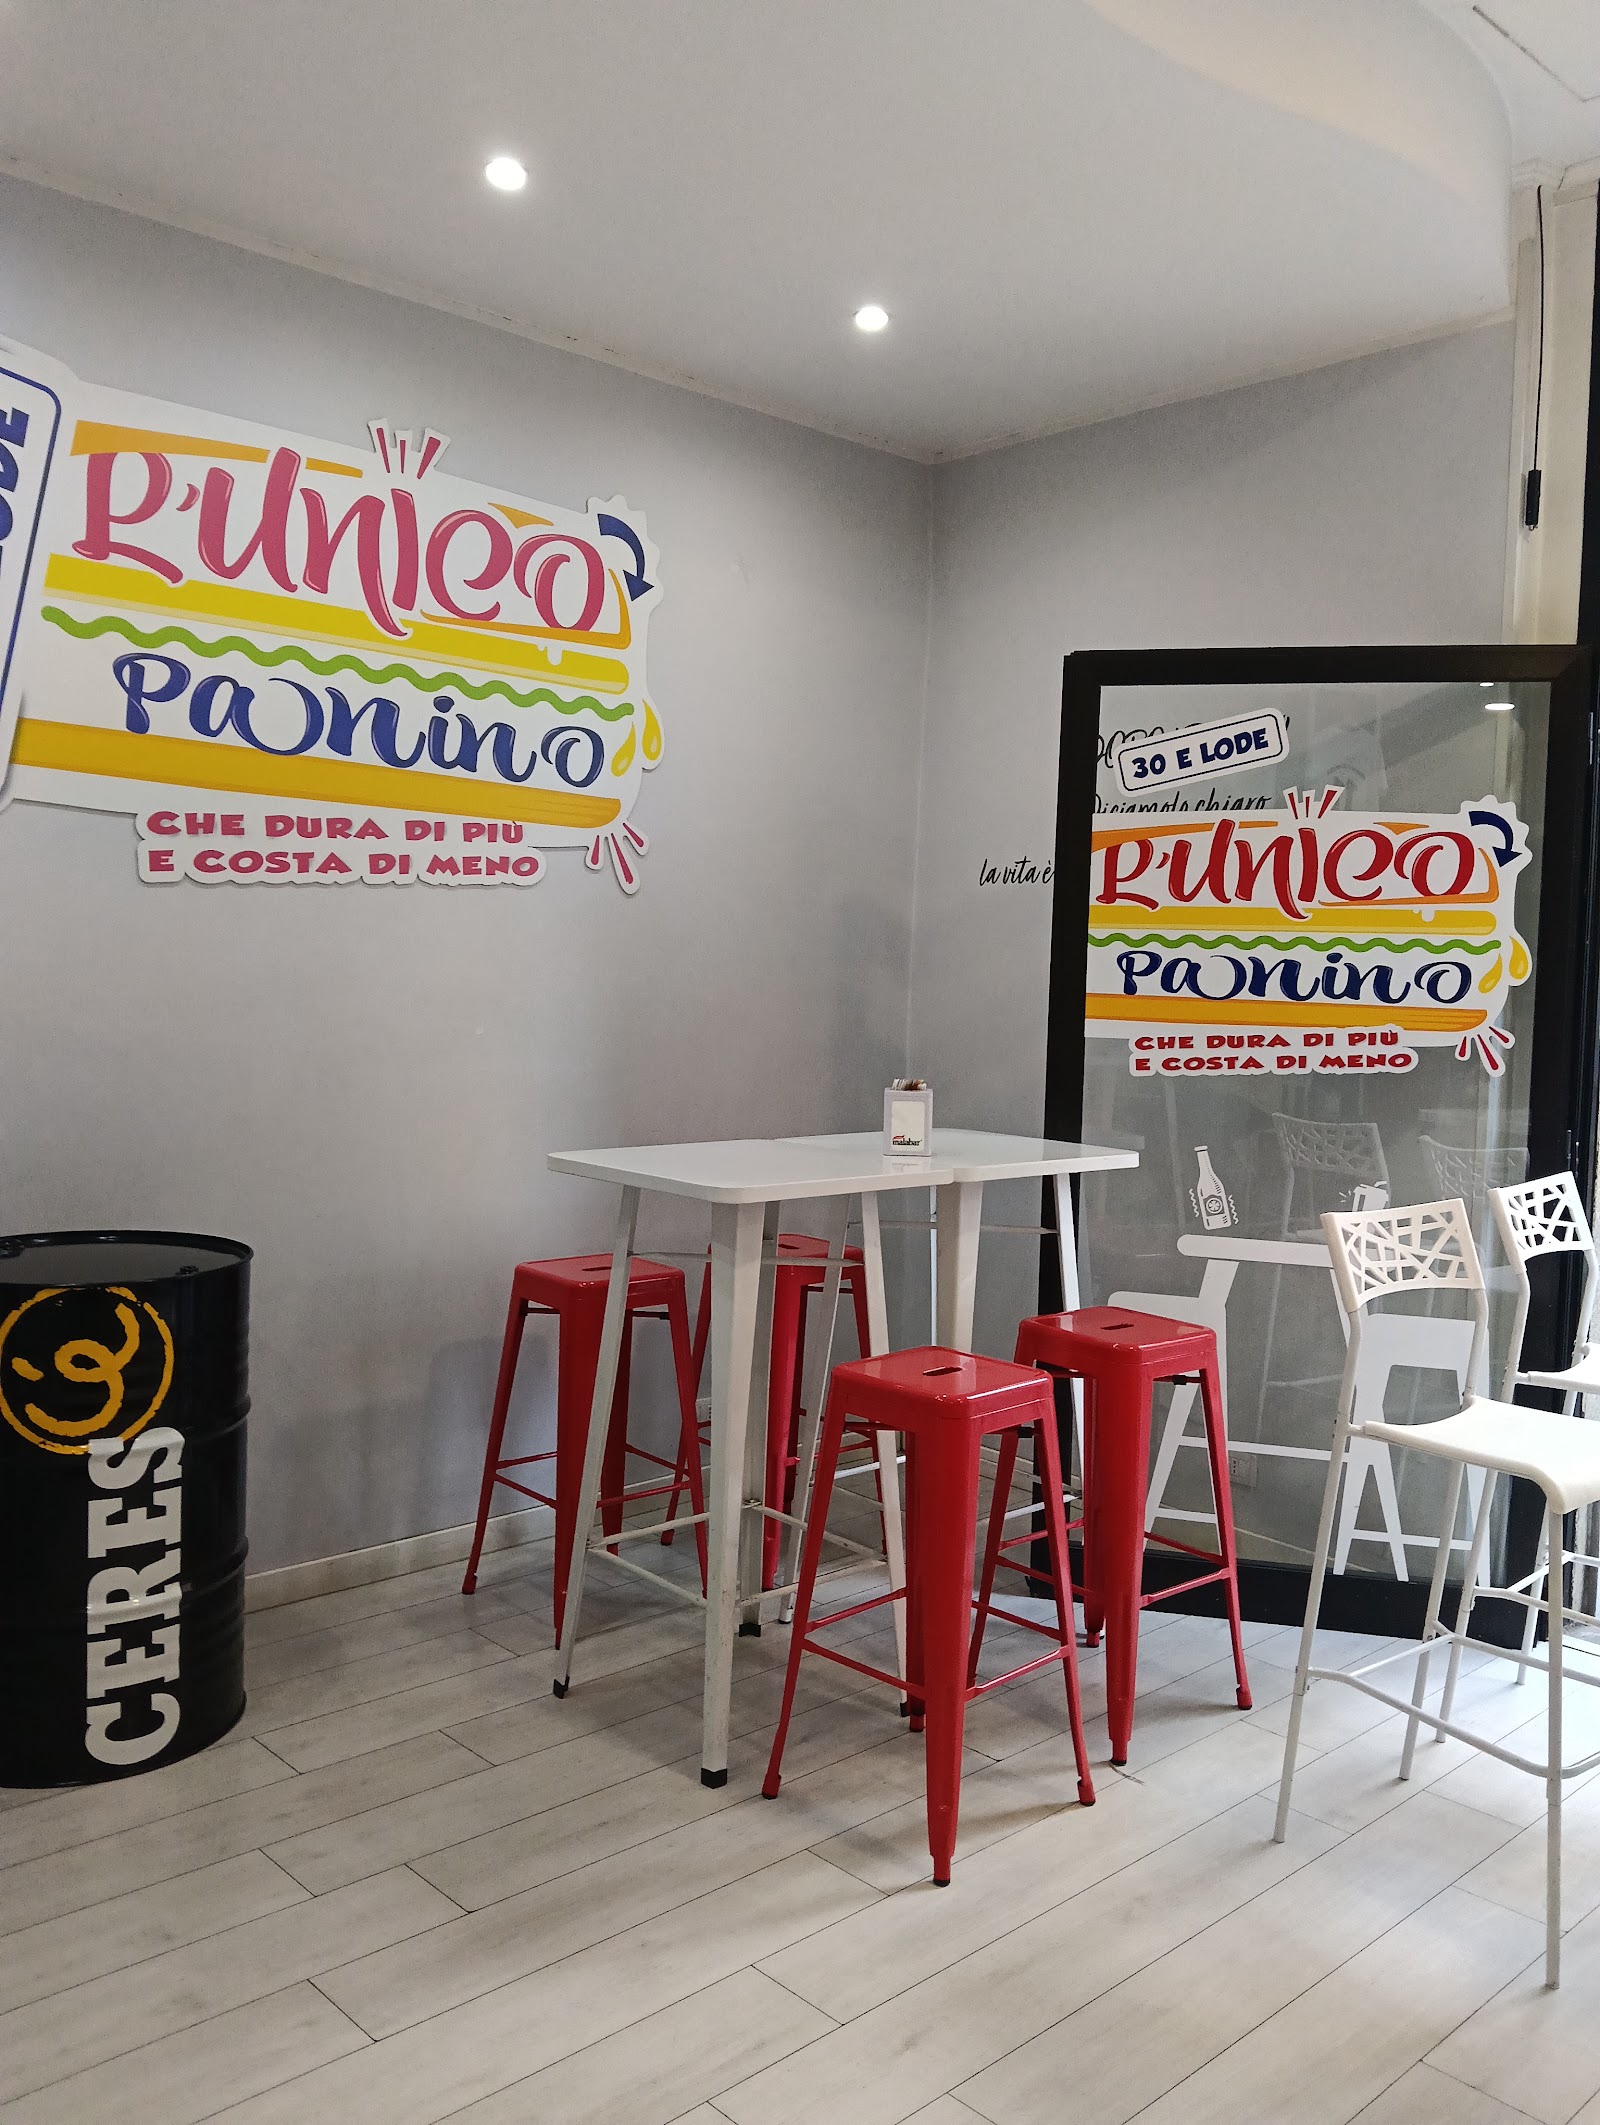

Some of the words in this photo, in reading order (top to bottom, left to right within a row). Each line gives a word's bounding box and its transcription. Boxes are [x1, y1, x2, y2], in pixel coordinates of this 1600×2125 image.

[1131, 753, 1166, 779] 30
[1176, 747, 1192, 770] E
[1199, 727, 1269, 764] LODE
[146, 810, 245, 836] CHE
[265, 814, 390, 840] DURA
[404, 819, 446, 842] DI
[462, 820, 524, 844] PIÙ
[148, 850, 174, 873] E
[192, 849, 353, 874] COSTA
[368, 852, 410, 875] DI
[426, 853, 540, 877] MENO
[980, 858, 1001, 886] la
[1002, 855, 1041, 885] vita
[1134, 1036, 1194, 1050] CHE
[1206, 1033, 1291, 1049] DURA
[1303, 1032, 1334, 1047] DI
[1348, 1029, 1399, 1046] PIÙ
[1135, 1058, 1151, 1071] E
[1161, 1056, 1265, 1071] COSTA
[1276, 1055, 1307, 1069] DI
[1318, 1053, 1412, 1069] MENO
[85, 1426, 186, 1766] CERES
